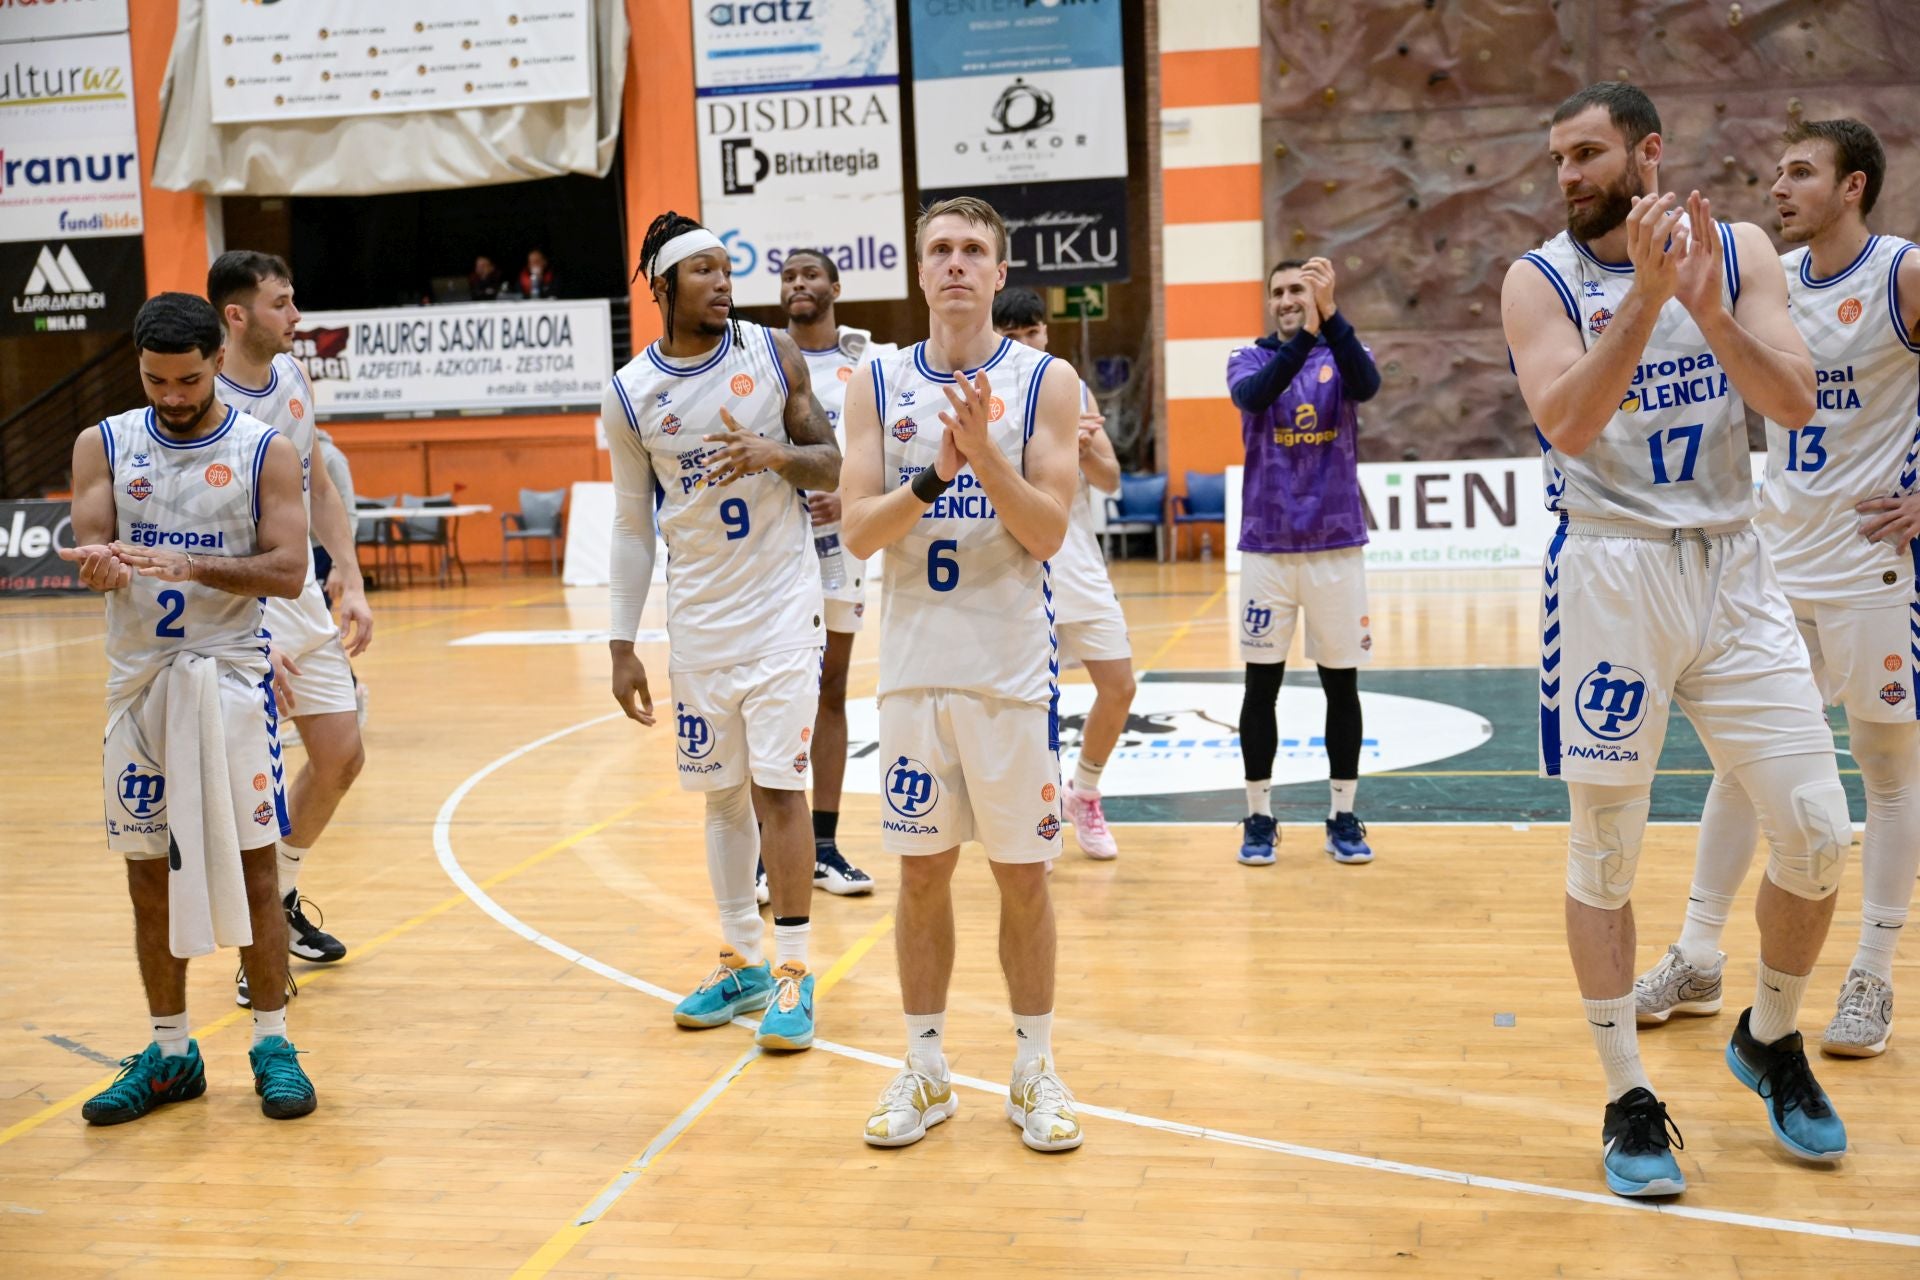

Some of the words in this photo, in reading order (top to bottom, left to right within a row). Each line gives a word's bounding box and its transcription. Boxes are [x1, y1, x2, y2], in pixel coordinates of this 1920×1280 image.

[706, 0, 814, 26] aratz
[707, 92, 889, 135] DISDIRA
[955, 134, 1088, 154] OLAKOR
[775, 148, 879, 176] Bitxitegia
[59, 209, 139, 231] fundibide
[767, 236, 898, 275] salle
[12, 292, 106, 313] LARRAMENDI
[355, 319, 432, 356] IRAURGI
[439, 317, 495, 352] SASKI
[501, 313, 573, 350] BALOIA
[357, 361, 422, 380] AZPEITIA
[434, 357, 502, 377] AZKOITIA
[515, 354, 574, 374] ZESTOA
[1632, 353, 1720, 385] gropa
[1647, 424, 1704, 485] 17
[1784, 426, 1828, 472] 13
[719, 497, 750, 541] 9
[130, 529, 224, 549] agropal
[927, 540, 960, 592] 6
[1410, 546, 1440, 562] eta
[155, 589, 185, 638] 2
[1568, 745, 1639, 762] INMAPA
[883, 820, 939, 834] INMAPA
